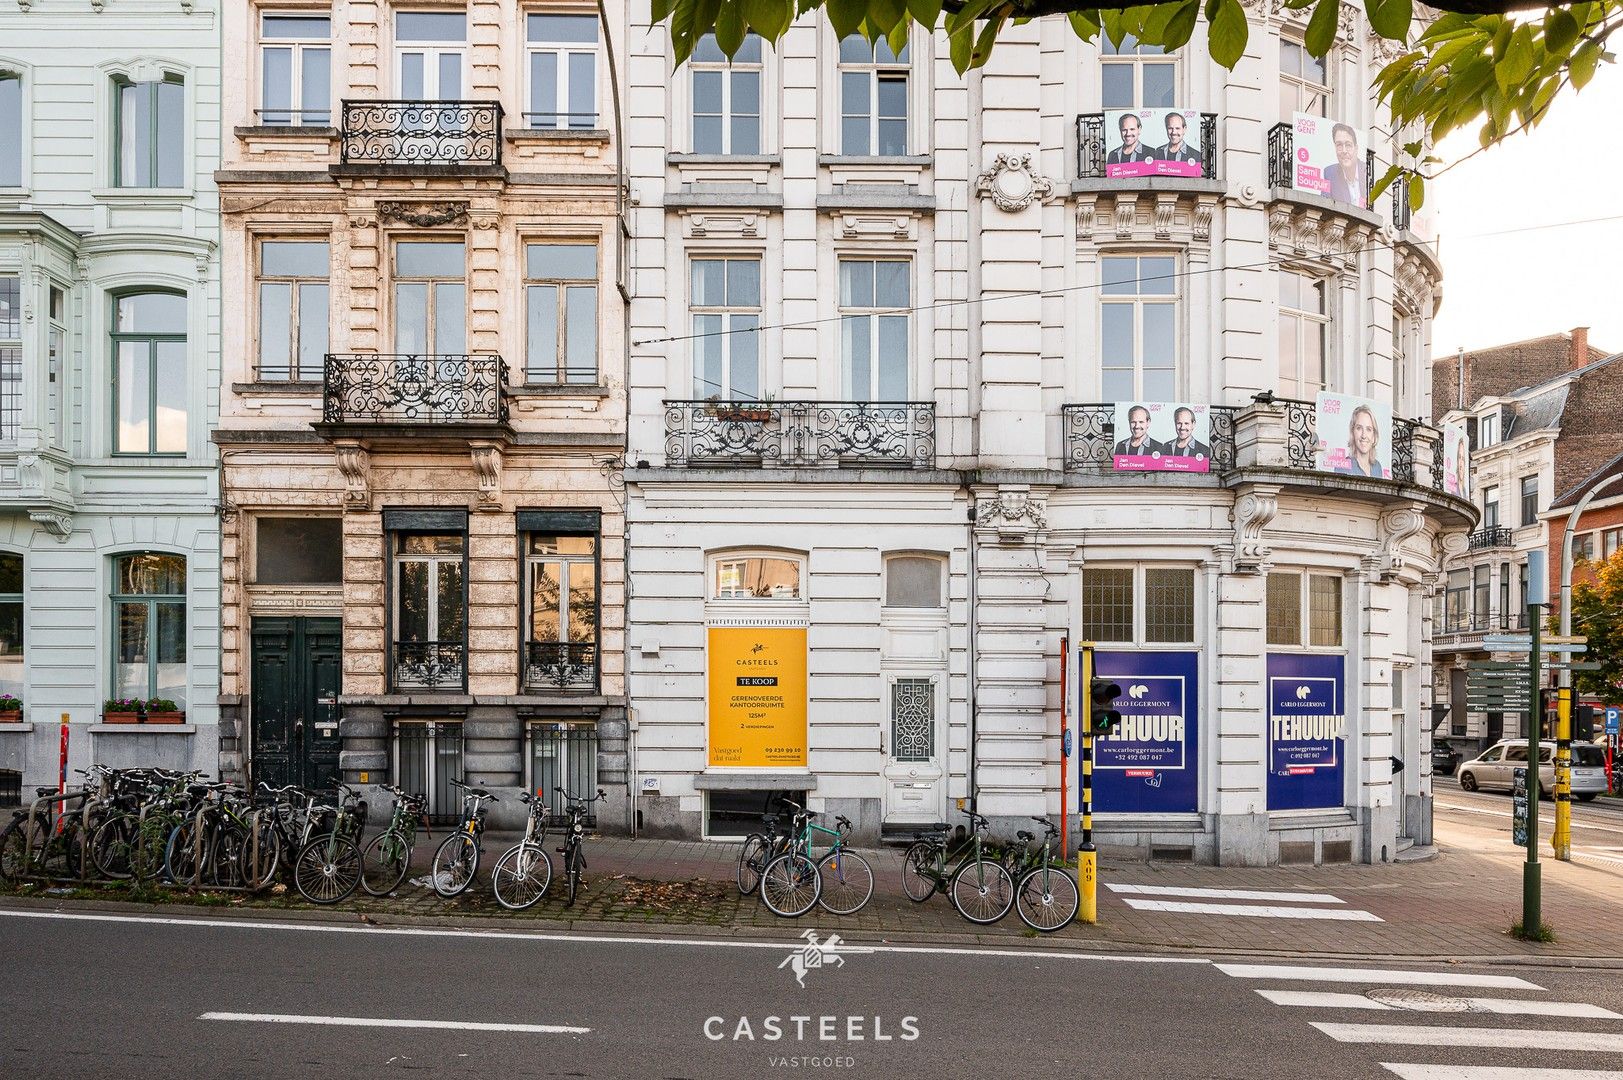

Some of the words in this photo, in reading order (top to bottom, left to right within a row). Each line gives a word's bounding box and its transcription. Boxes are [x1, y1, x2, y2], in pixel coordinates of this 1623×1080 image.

[1297, 119, 1315, 127] VOOR
[1297, 126, 1315, 135] GENT
[1298, 166, 1318, 177] Sami
[1298, 176, 1329, 191] Souguir
[1323, 406, 1340, 414] GENT
[1607, 710, 1617, 725] P
[1098, 715, 1184, 741] EHUUR
[713, 747, 742, 755] Vastgoed
[713, 754, 723, 762] dat
[725, 754, 741, 762] raakt
